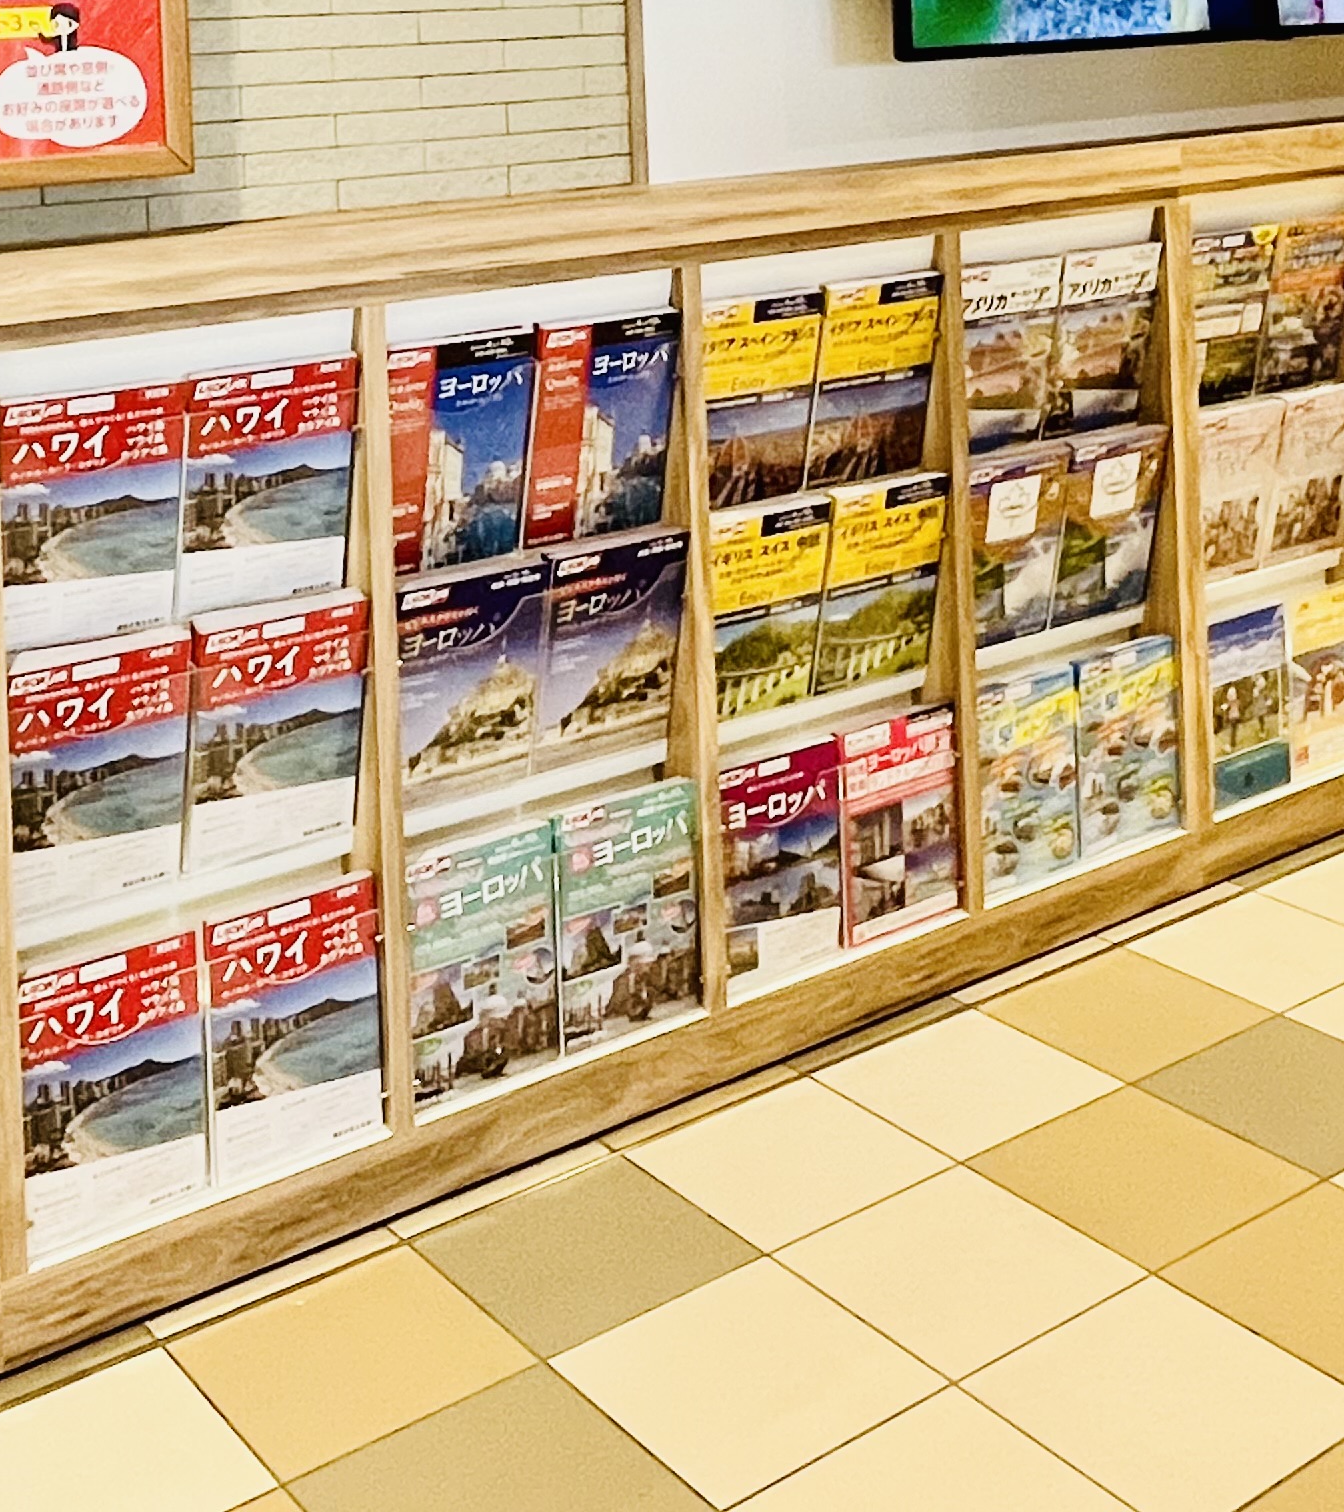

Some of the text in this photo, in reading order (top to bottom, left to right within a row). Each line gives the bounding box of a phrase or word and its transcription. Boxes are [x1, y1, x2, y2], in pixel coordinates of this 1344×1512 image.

[592, 343, 670, 376] ヨーロッパ
[438, 368, 524, 399] ヨーロッパ
[200, 397, 290, 436] ハワイ
[11, 425, 110, 464] ハワイ
[212, 645, 301, 689] ハワイ
[17, 687, 116, 733] ハワイ
[728, 778, 826, 830] ヨーロッパ
[592, 810, 689, 867] ヨーロッパ
[438, 855, 544, 920] ヨーロッパ
[222, 930, 309, 983] ハワイ
[27, 988, 124, 1044] ハワイ
